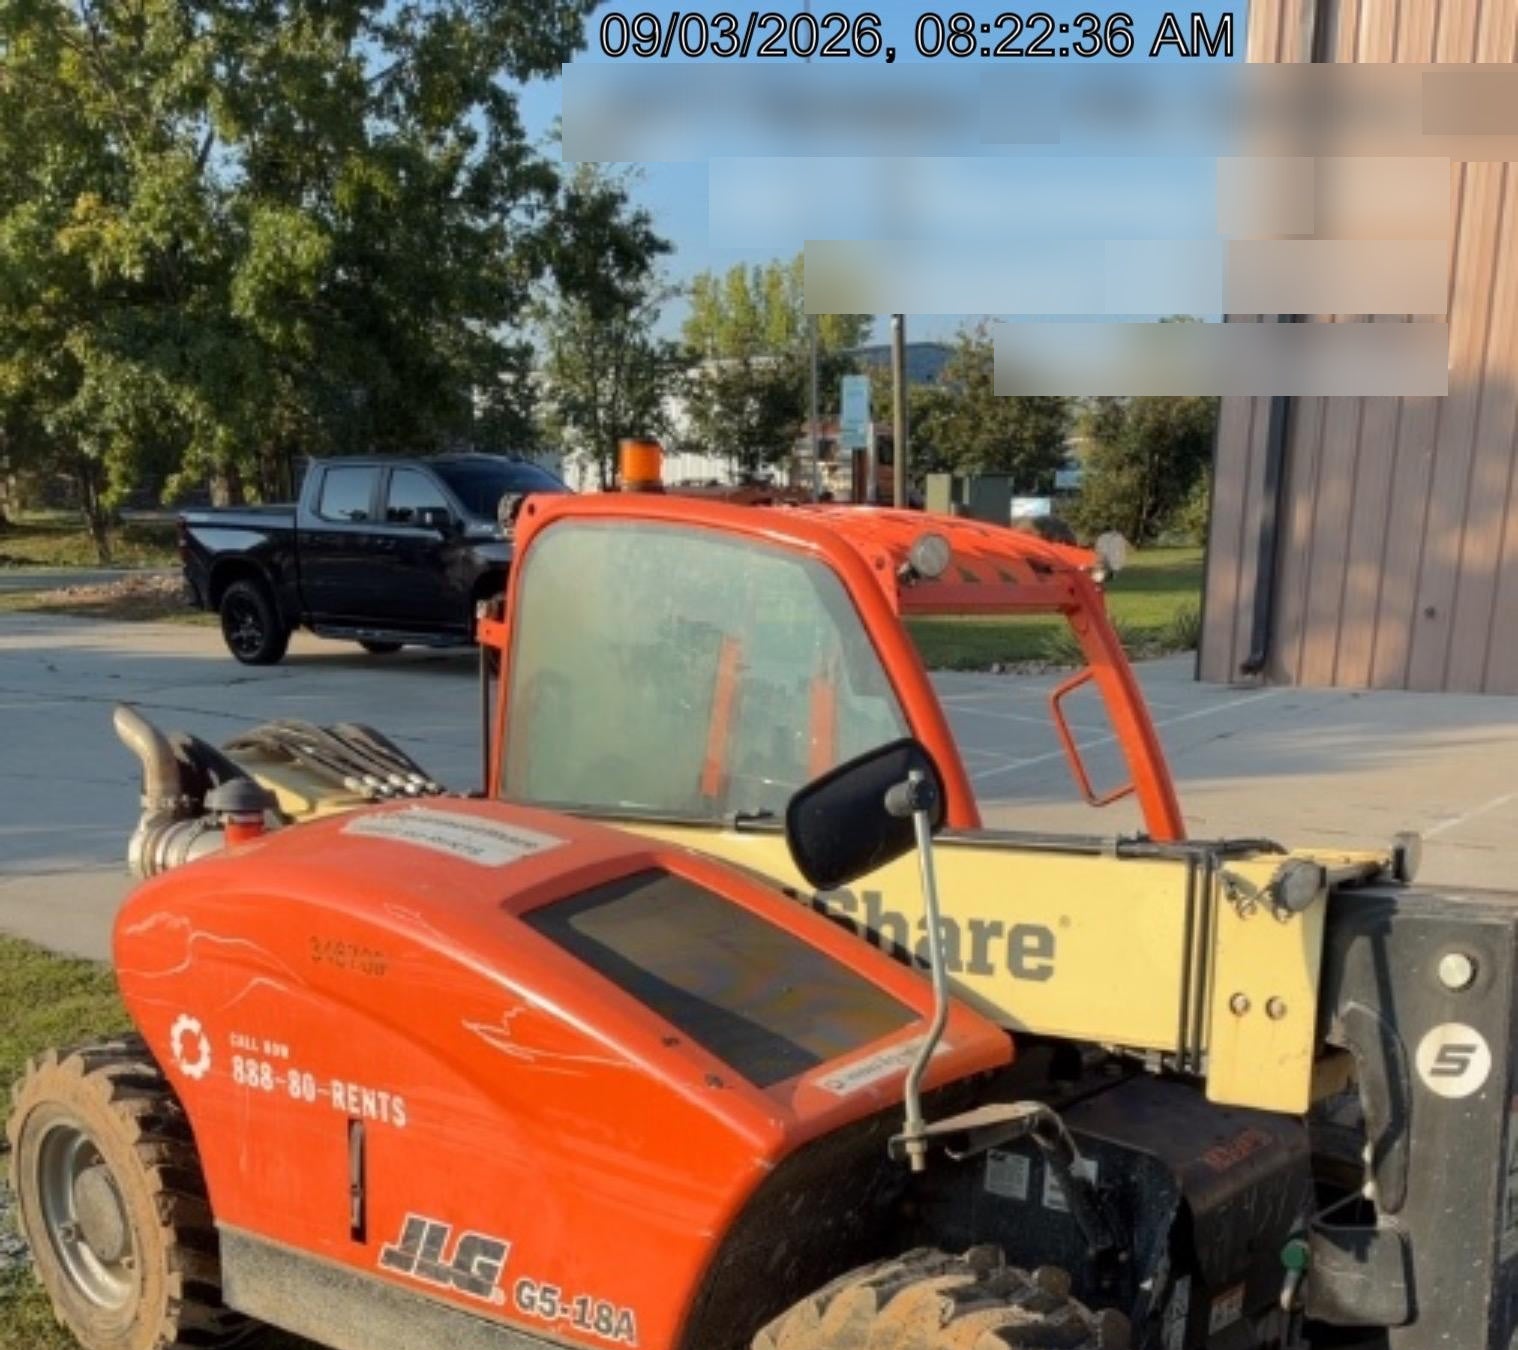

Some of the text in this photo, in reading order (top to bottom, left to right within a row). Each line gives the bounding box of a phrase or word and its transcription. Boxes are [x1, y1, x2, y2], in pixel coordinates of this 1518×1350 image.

[229, 1031, 259, 1051] CALL
[232, 1055, 407, 1128] 888-80-RENTS
[378, 1212, 511, 1302] JLG
[515, 1277, 638, 1347] G5-18A
